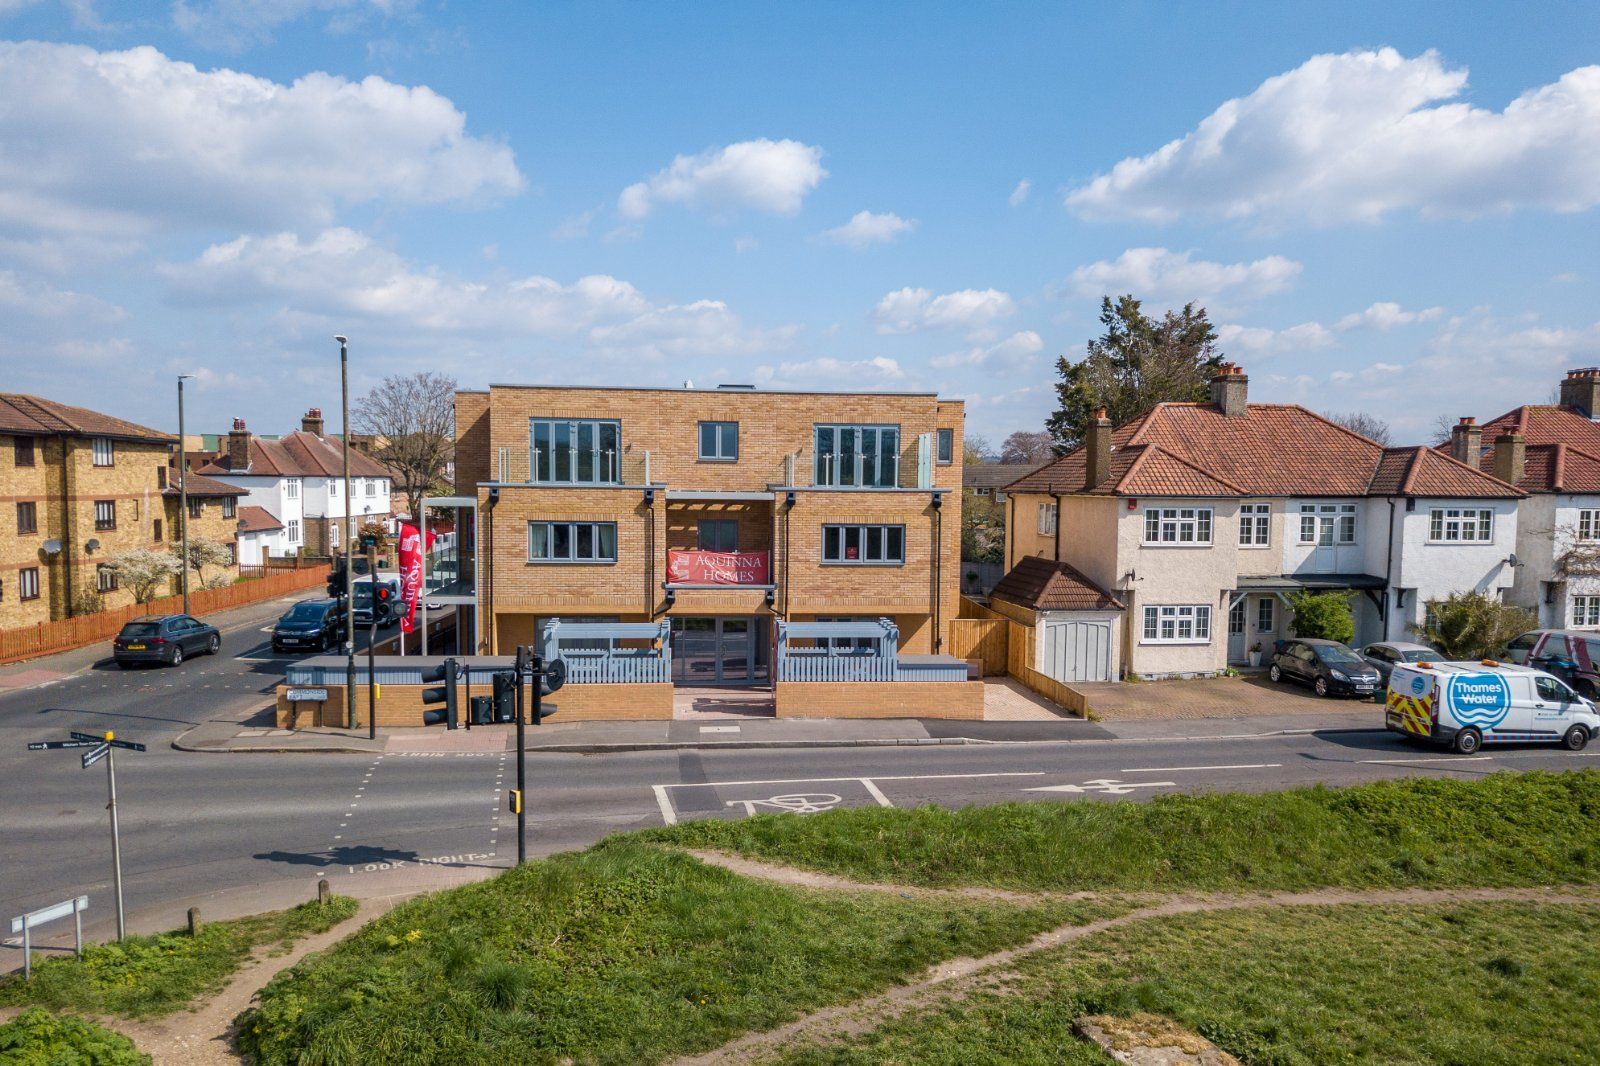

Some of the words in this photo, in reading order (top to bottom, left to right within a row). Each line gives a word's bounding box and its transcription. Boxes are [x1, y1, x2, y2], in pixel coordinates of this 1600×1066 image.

[695, 554, 762, 568] AQUINNA
[703, 569, 754, 582] HOMES
[1455, 681, 1502, 693] Thames
[1462, 694, 1498, 705] Water
[349, 860, 407, 874] LOOK
